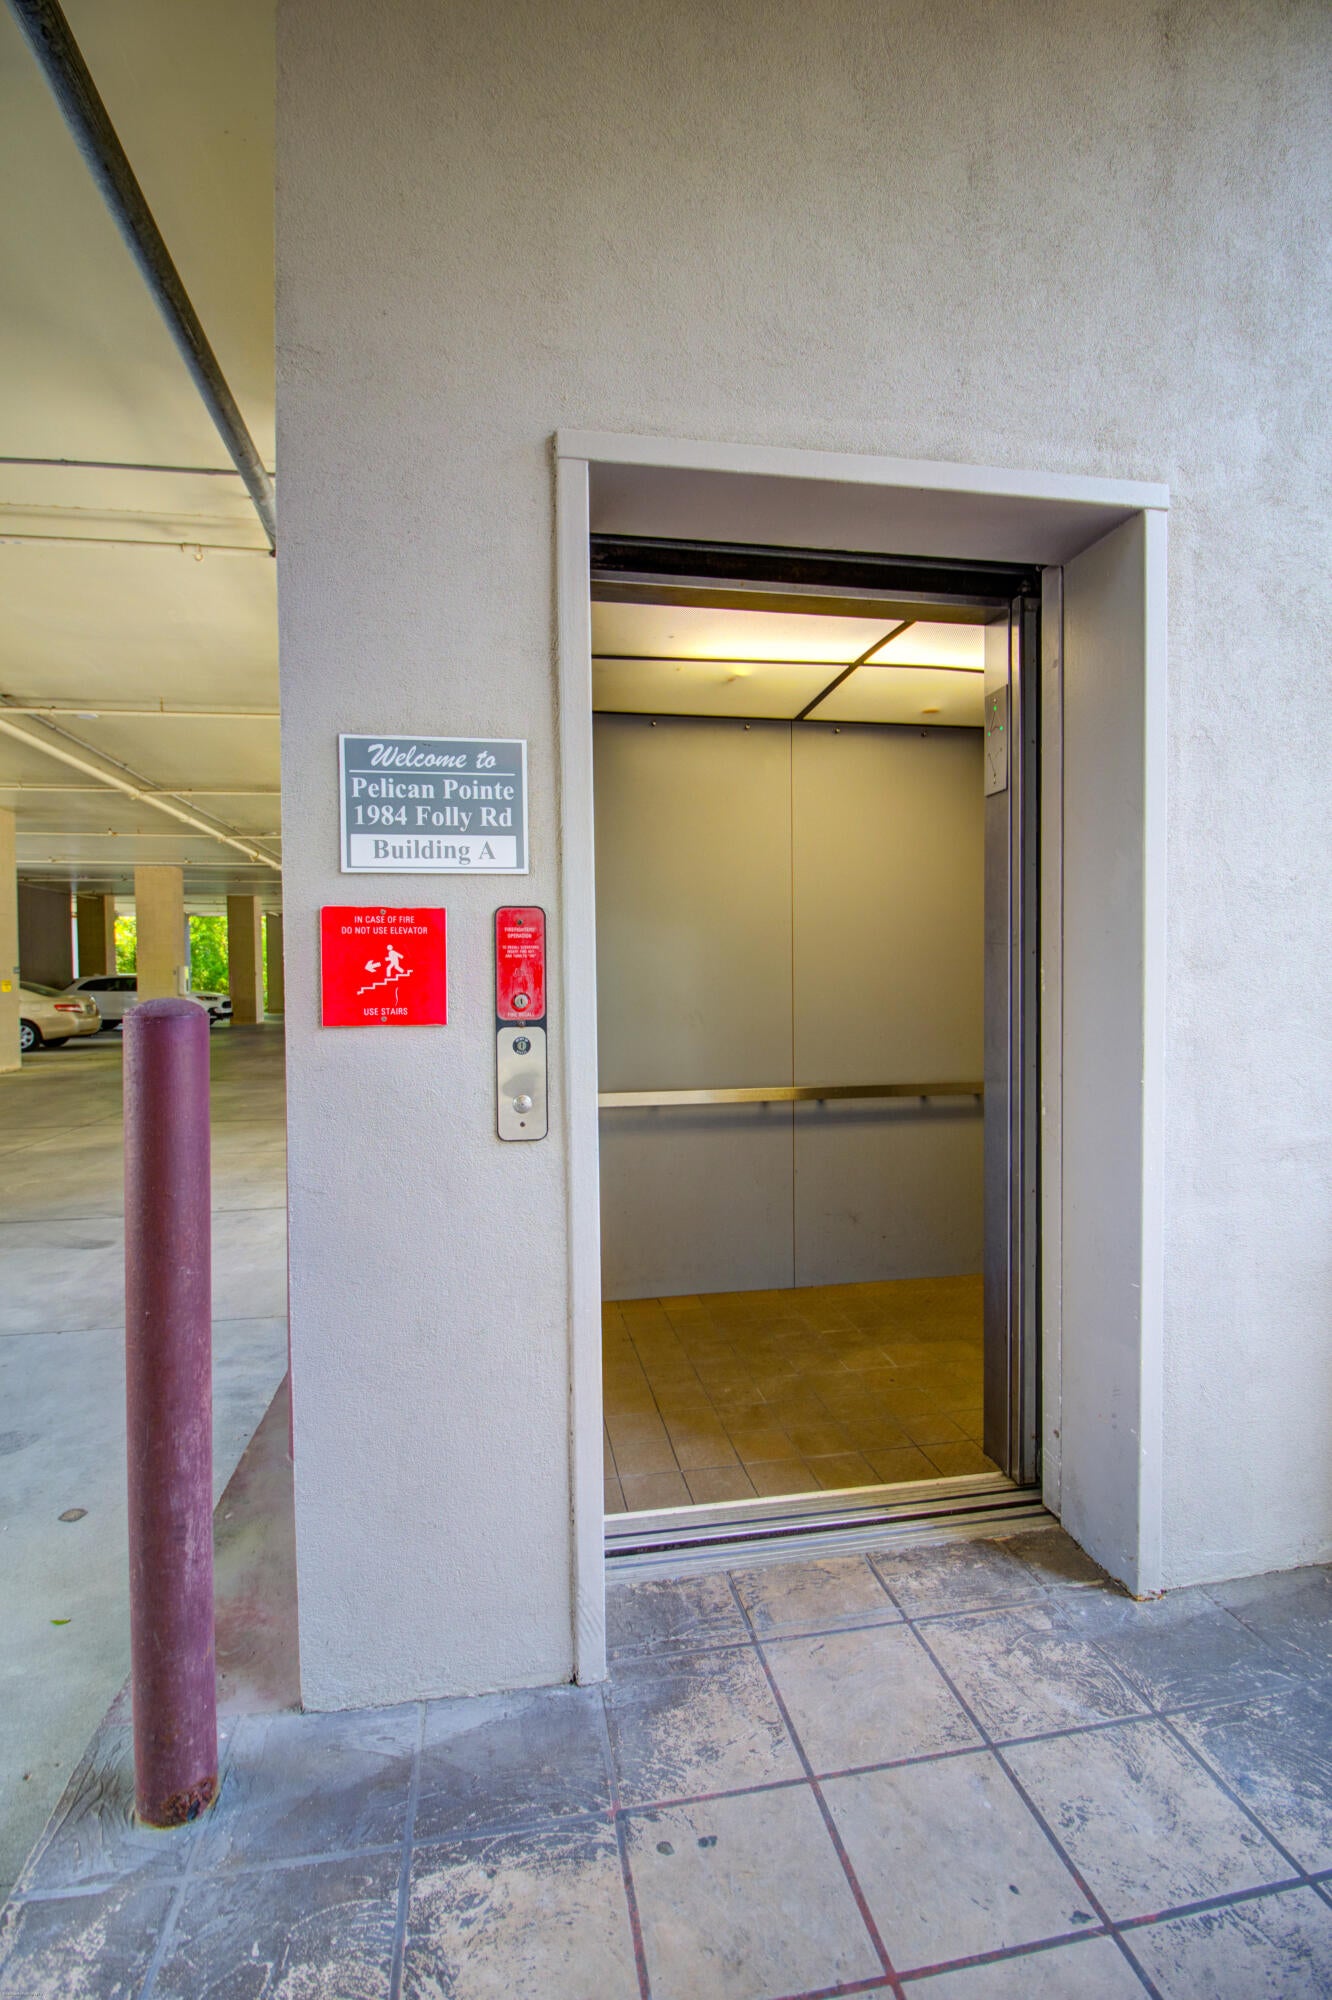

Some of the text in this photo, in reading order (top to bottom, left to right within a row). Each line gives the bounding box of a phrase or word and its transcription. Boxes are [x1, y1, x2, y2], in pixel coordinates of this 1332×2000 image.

[367, 743, 497, 769] Welcome to
[351, 777, 514, 800] Pelican Pointe
[354, 805, 513, 832] 1984 Folly Rd
[373, 839, 496, 865] Building A
